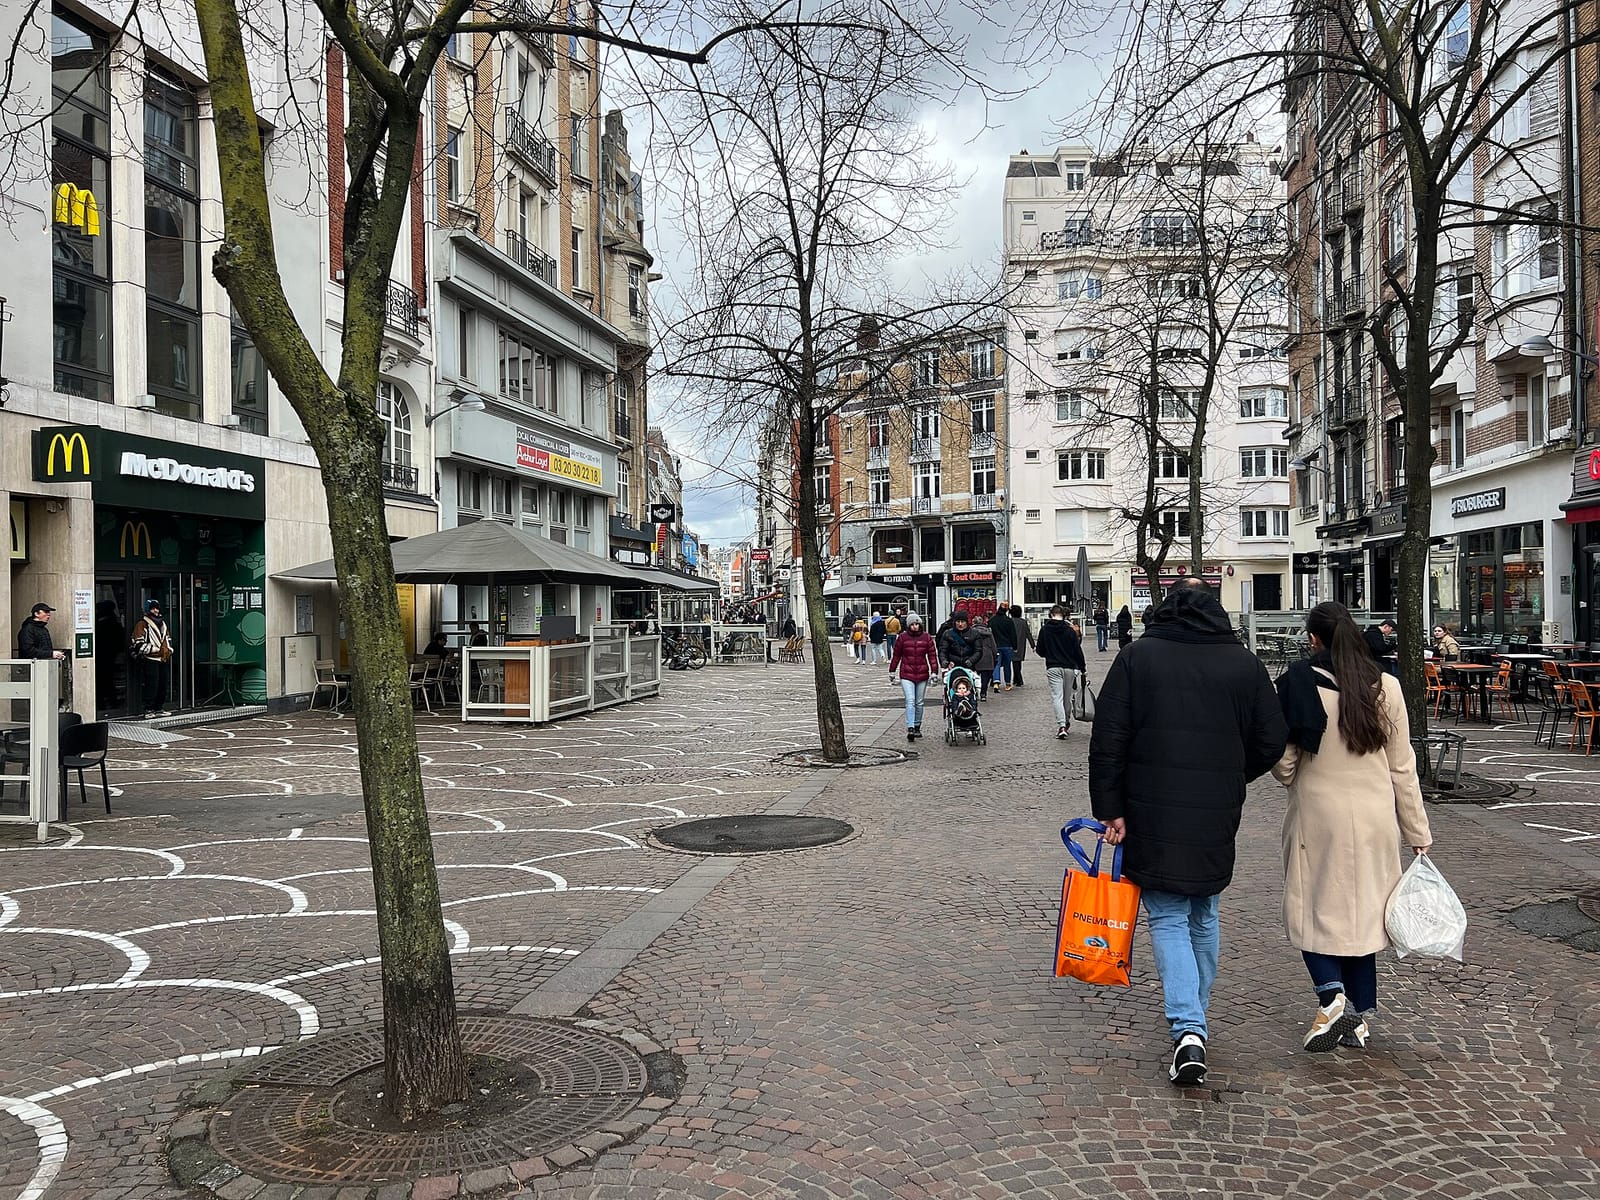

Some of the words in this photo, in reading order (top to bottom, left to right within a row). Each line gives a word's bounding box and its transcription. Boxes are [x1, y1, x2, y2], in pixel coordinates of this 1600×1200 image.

[120, 451, 255, 493] McDonald's
[553, 458, 562, 472] 03
[563, 461, 572, 475] 20
[573, 464, 580, 477] 30
[582, 467, 590, 480] 22
[591, 470, 598, 482] 18
[1456, 491, 1501, 513] BIOBURGER
[952, 573, 968, 581] Tout
[969, 572, 993, 581] Chaud
[1131, 567, 1173, 575] PLET
